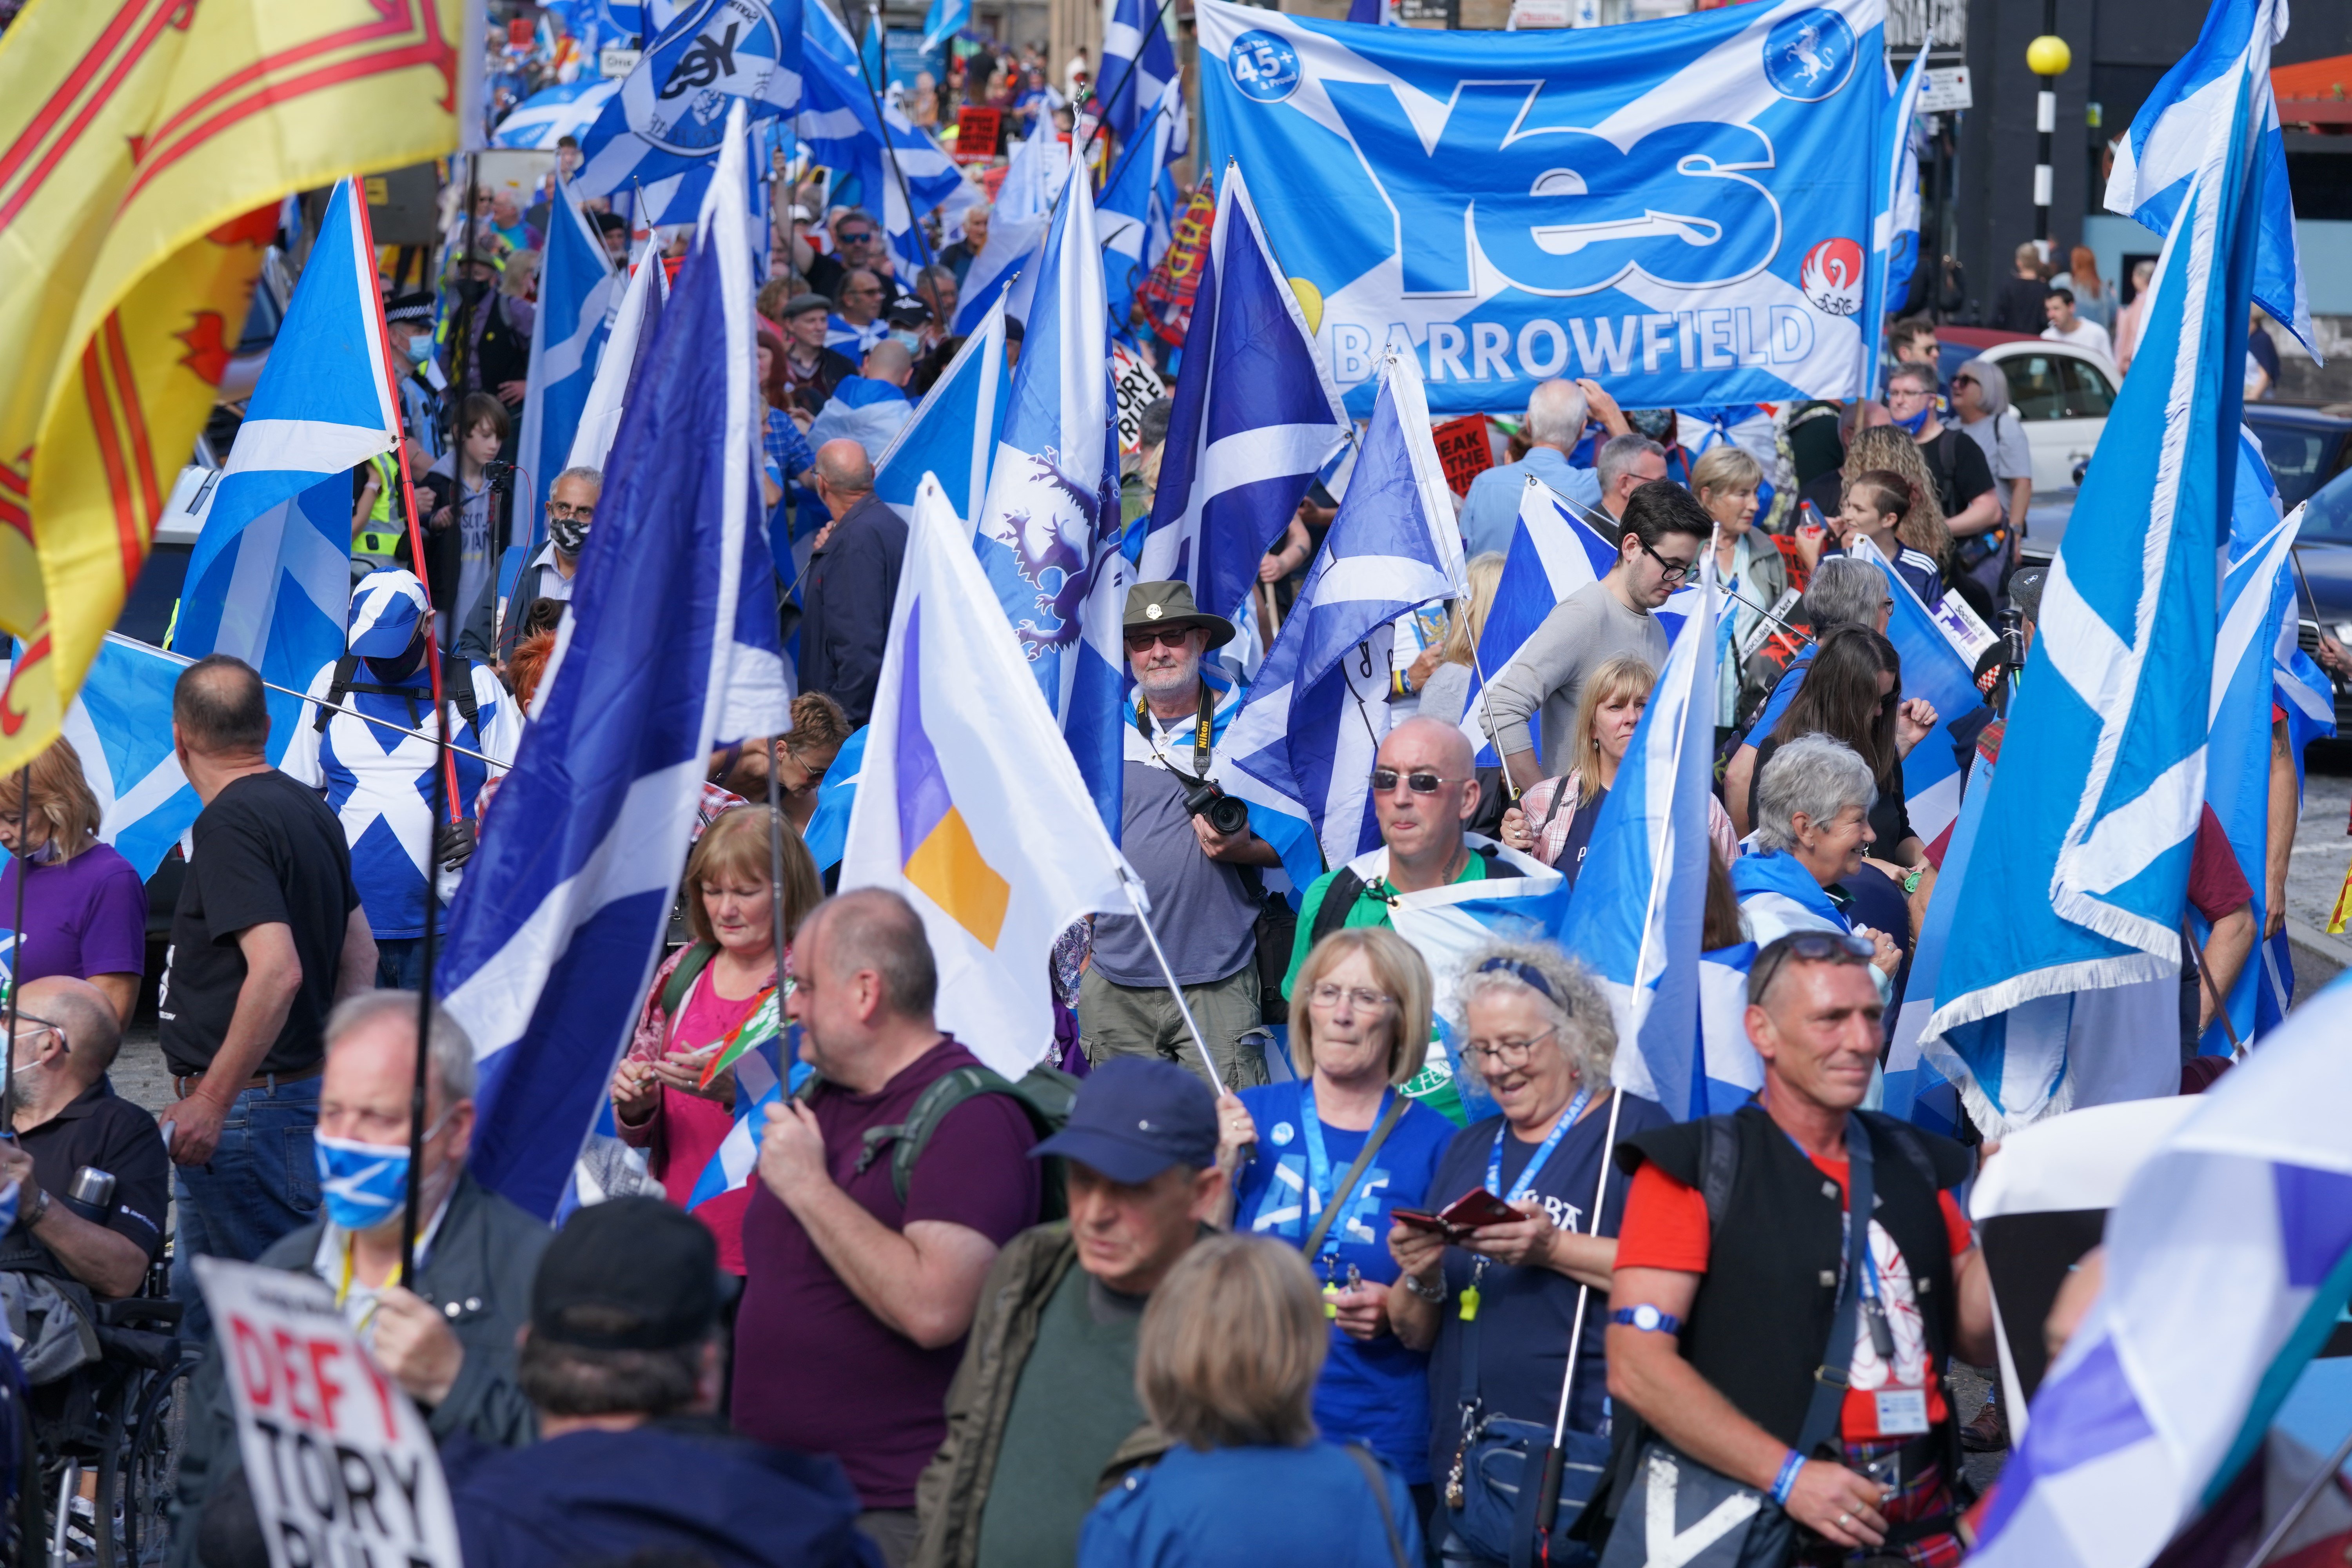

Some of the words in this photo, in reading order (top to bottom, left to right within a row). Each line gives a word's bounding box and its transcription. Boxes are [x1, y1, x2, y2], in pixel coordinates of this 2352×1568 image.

[1252, 39, 1269, 48] Yes
[1269, 71, 1297, 88] Proud
[1319, 78, 1782, 299] Yes
[1333, 305, 1815, 384] BARROWFIELD
[1116, 361, 1149, 410] ORY
[1439, 430, 1480, 458] EAK
[1446, 447, 1486, 474] THE
[1198, 720, 1209, 749] Nikon
[229, 1310, 398, 1443] DEFY
[253, 1417, 423, 1543] TORY
